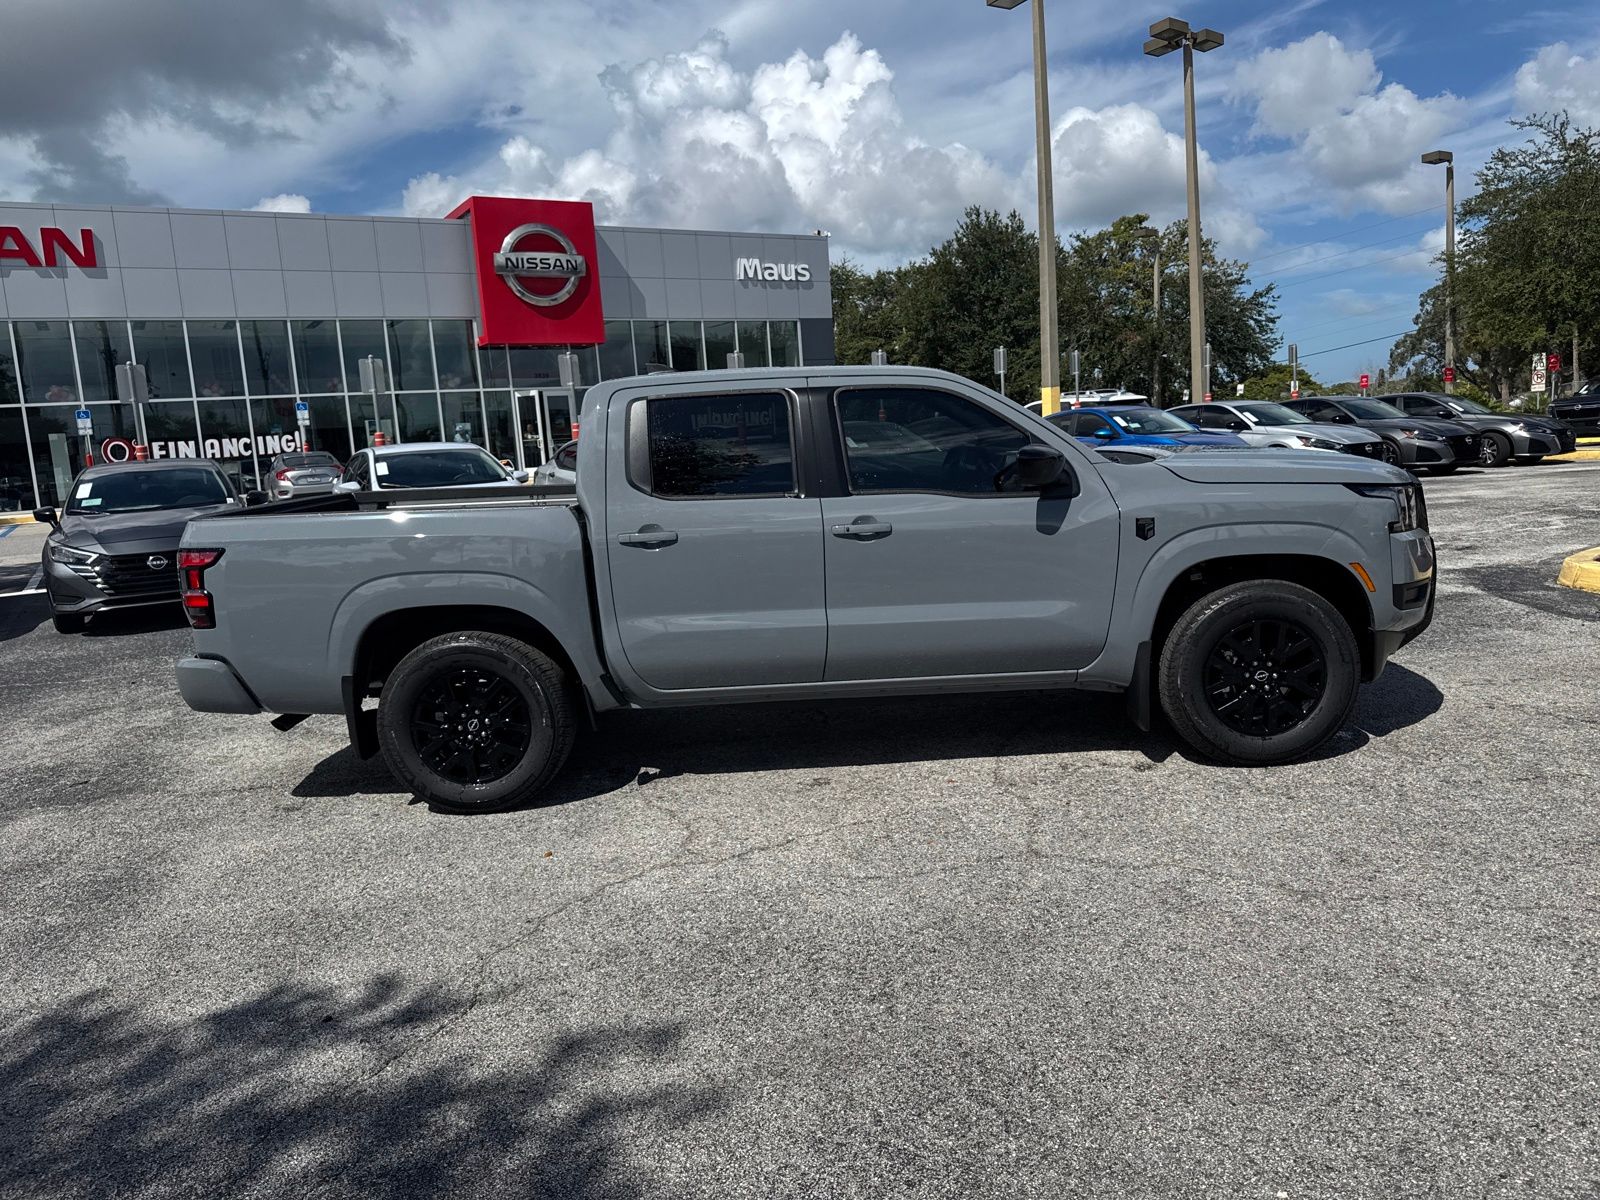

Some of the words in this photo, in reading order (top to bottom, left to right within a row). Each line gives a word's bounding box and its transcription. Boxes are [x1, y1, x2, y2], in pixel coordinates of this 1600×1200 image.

[505, 257, 578, 271] NISSAN
[737, 258, 811, 281] Maus
[152, 431, 301, 459] FINANCING!
